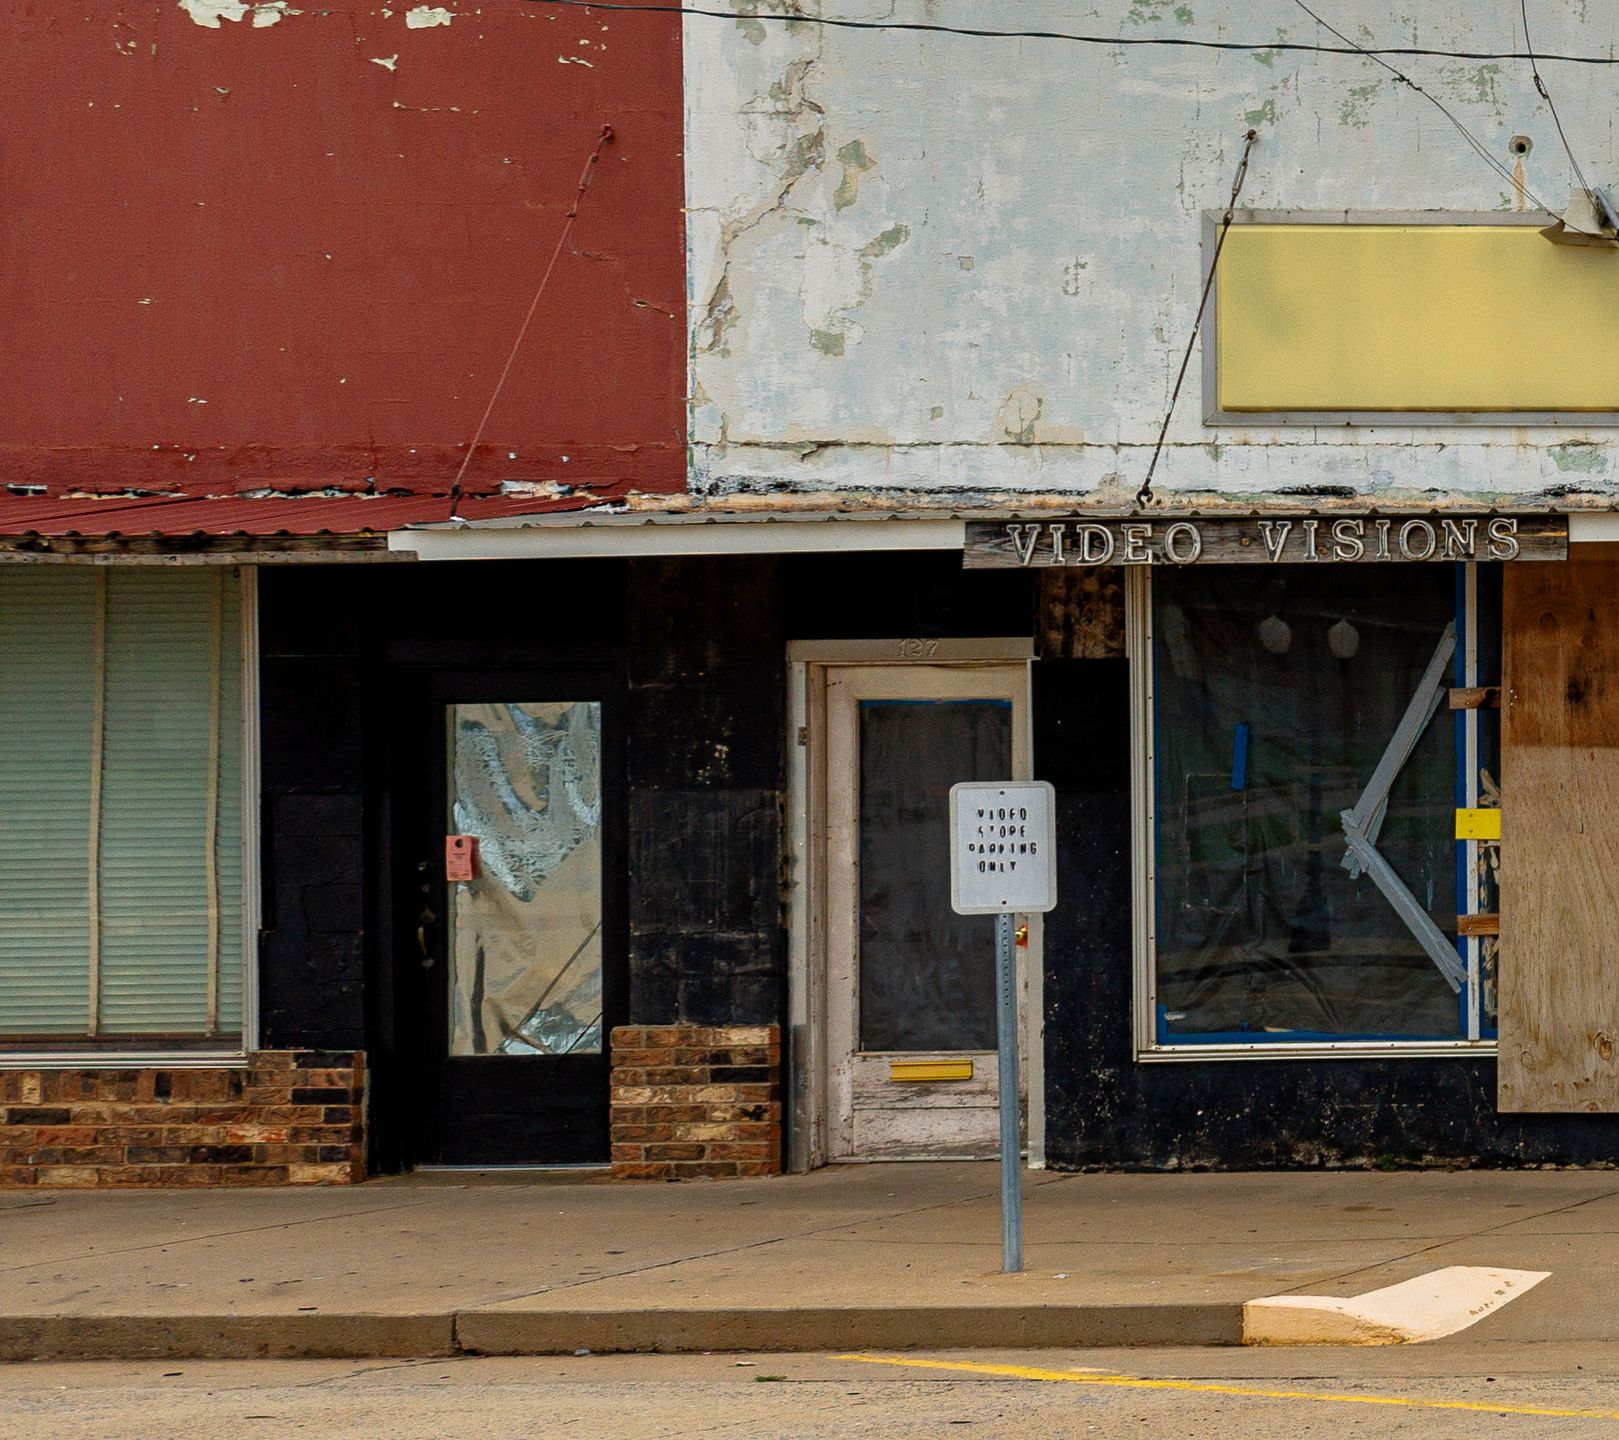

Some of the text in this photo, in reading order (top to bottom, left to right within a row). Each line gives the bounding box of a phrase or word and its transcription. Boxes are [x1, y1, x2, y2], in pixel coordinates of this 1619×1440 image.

[1006, 517, 1518, 567] VIDEO VISIONS
[978, 807, 1027, 821] VIDEO
[968, 842, 1037, 855] PARKING
[979, 860, 1016, 873] ONLY
